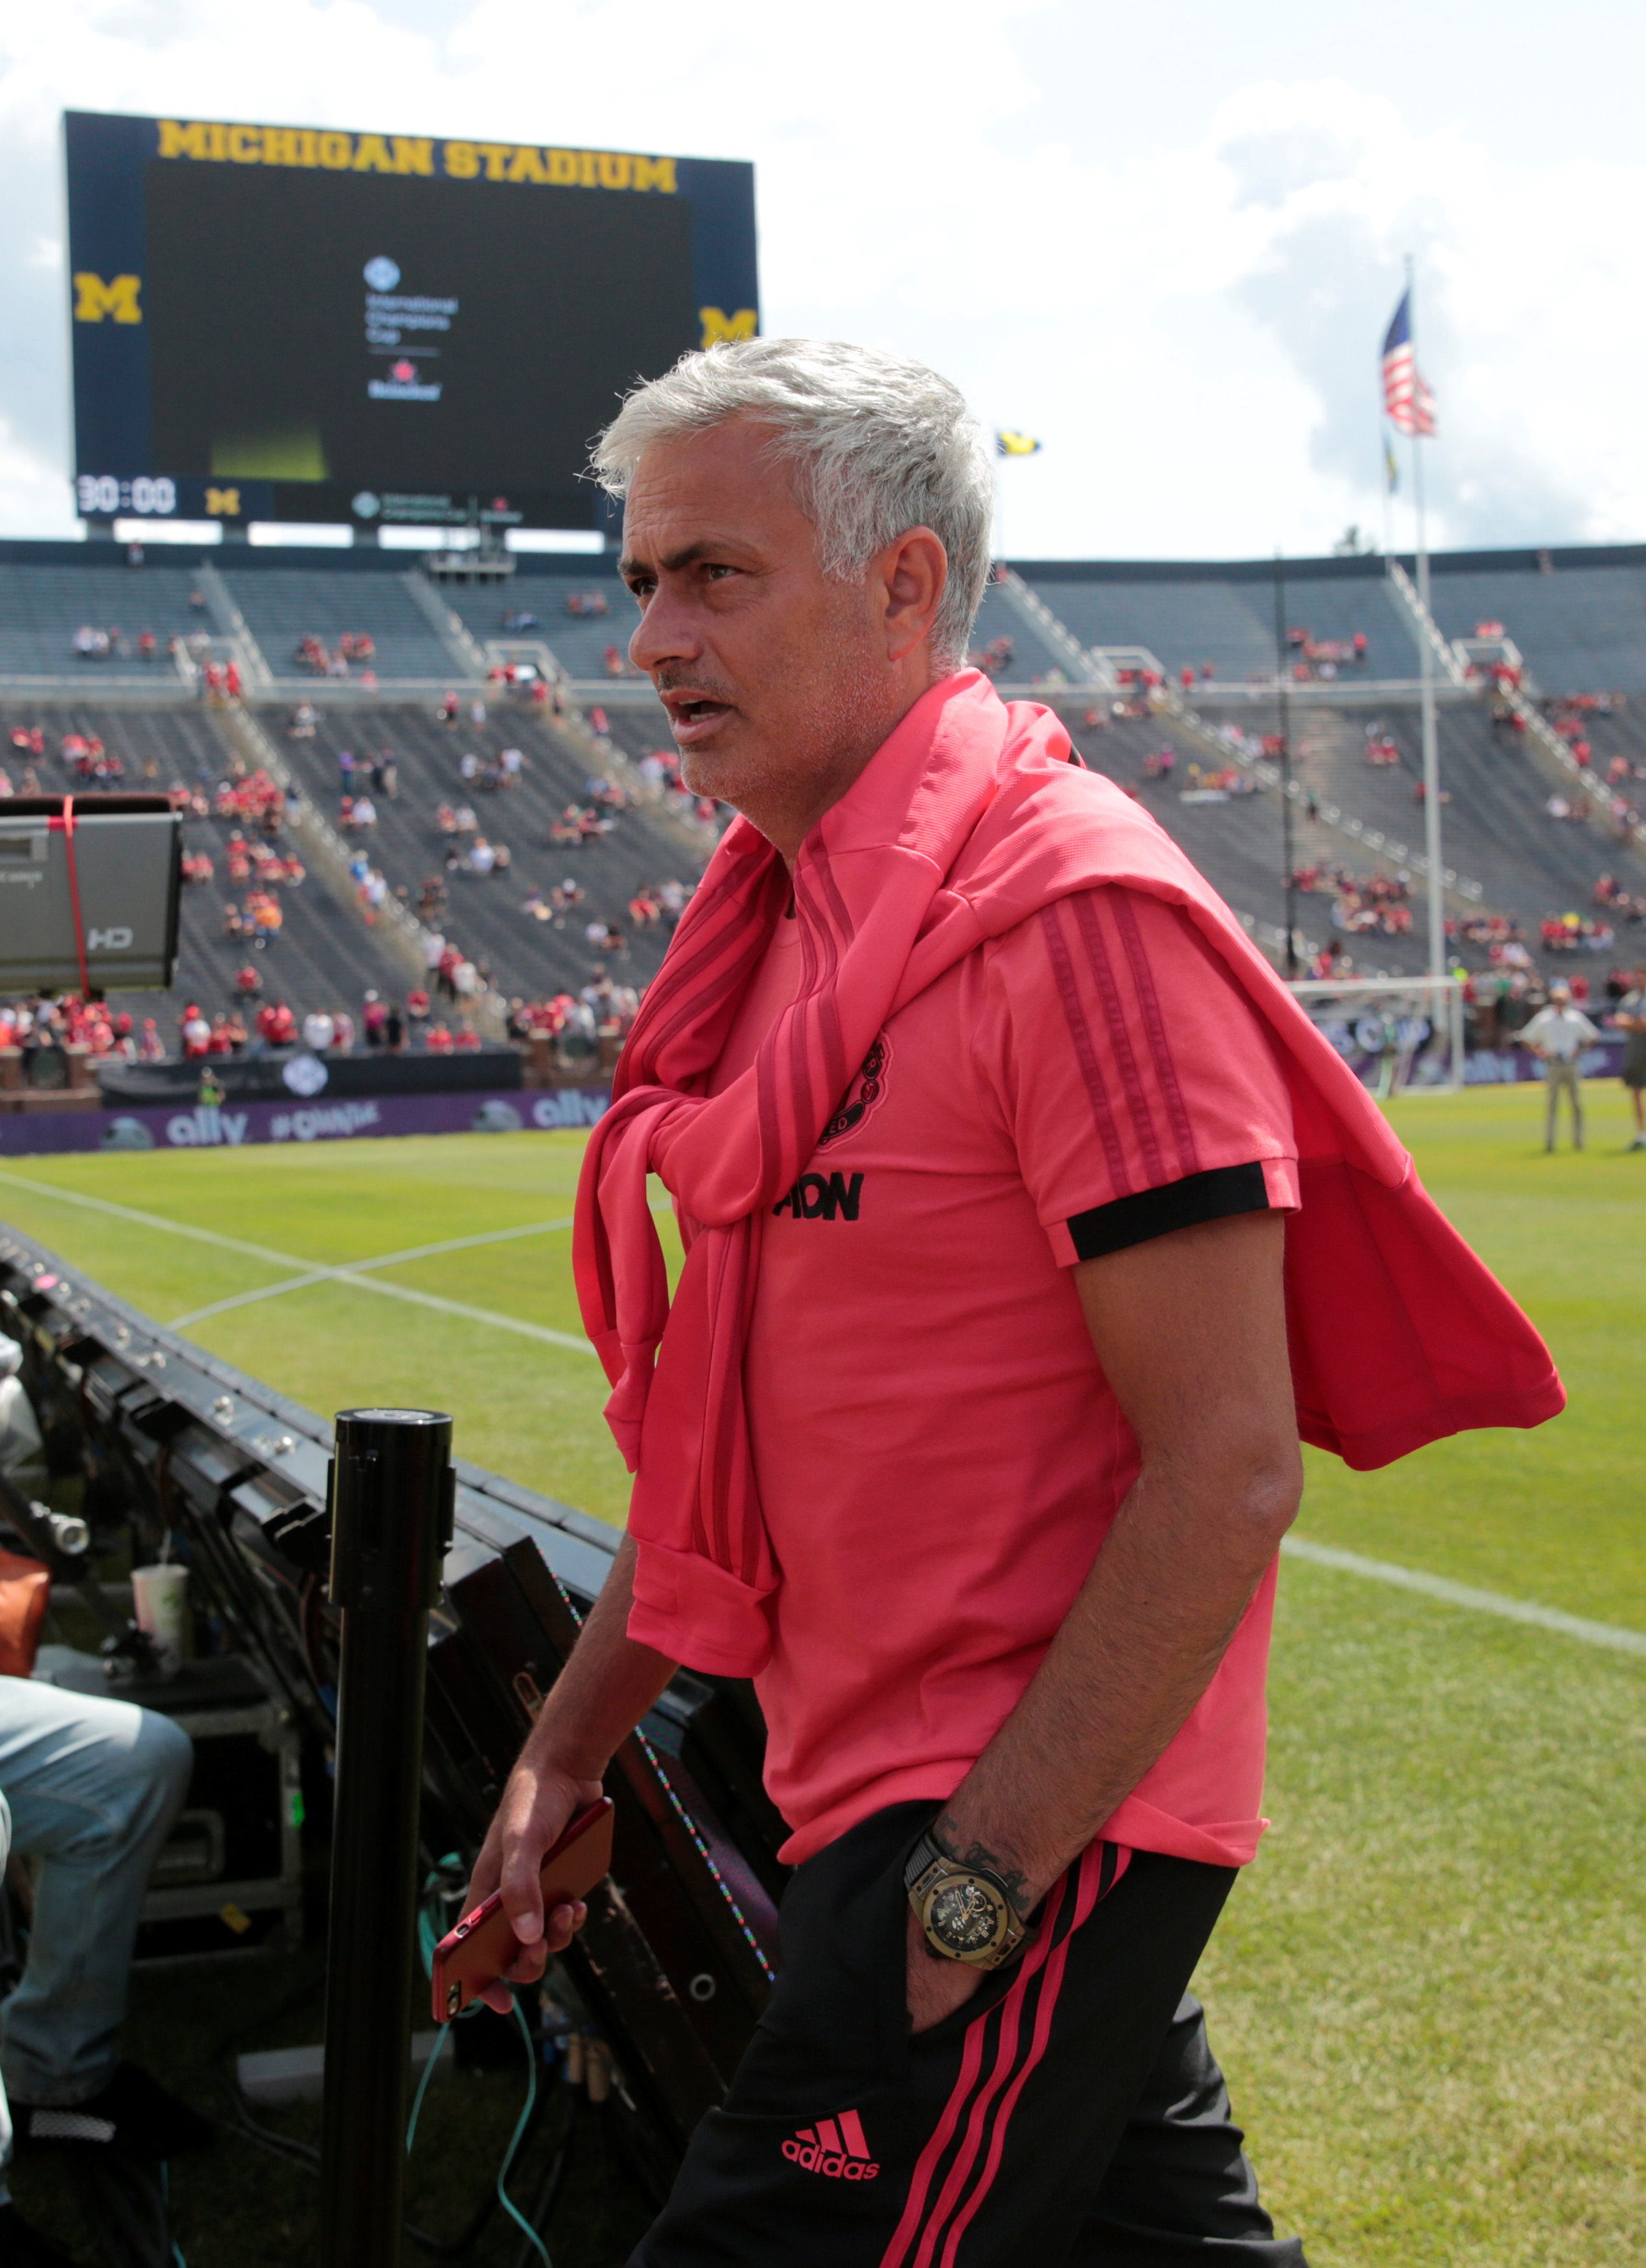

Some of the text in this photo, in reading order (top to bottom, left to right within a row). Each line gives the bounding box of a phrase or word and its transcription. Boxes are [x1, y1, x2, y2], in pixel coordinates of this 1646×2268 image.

[158, 119, 678, 193] MICHIGAN STADIUM
[74, 272, 142, 324] M
[699, 306, 757, 350] M
[87, 927, 133, 951] HD
[166, 1105, 248, 1146] ally
[533, 1088, 609, 1128] ally
[782, 2139, 881, 2181] adidas
